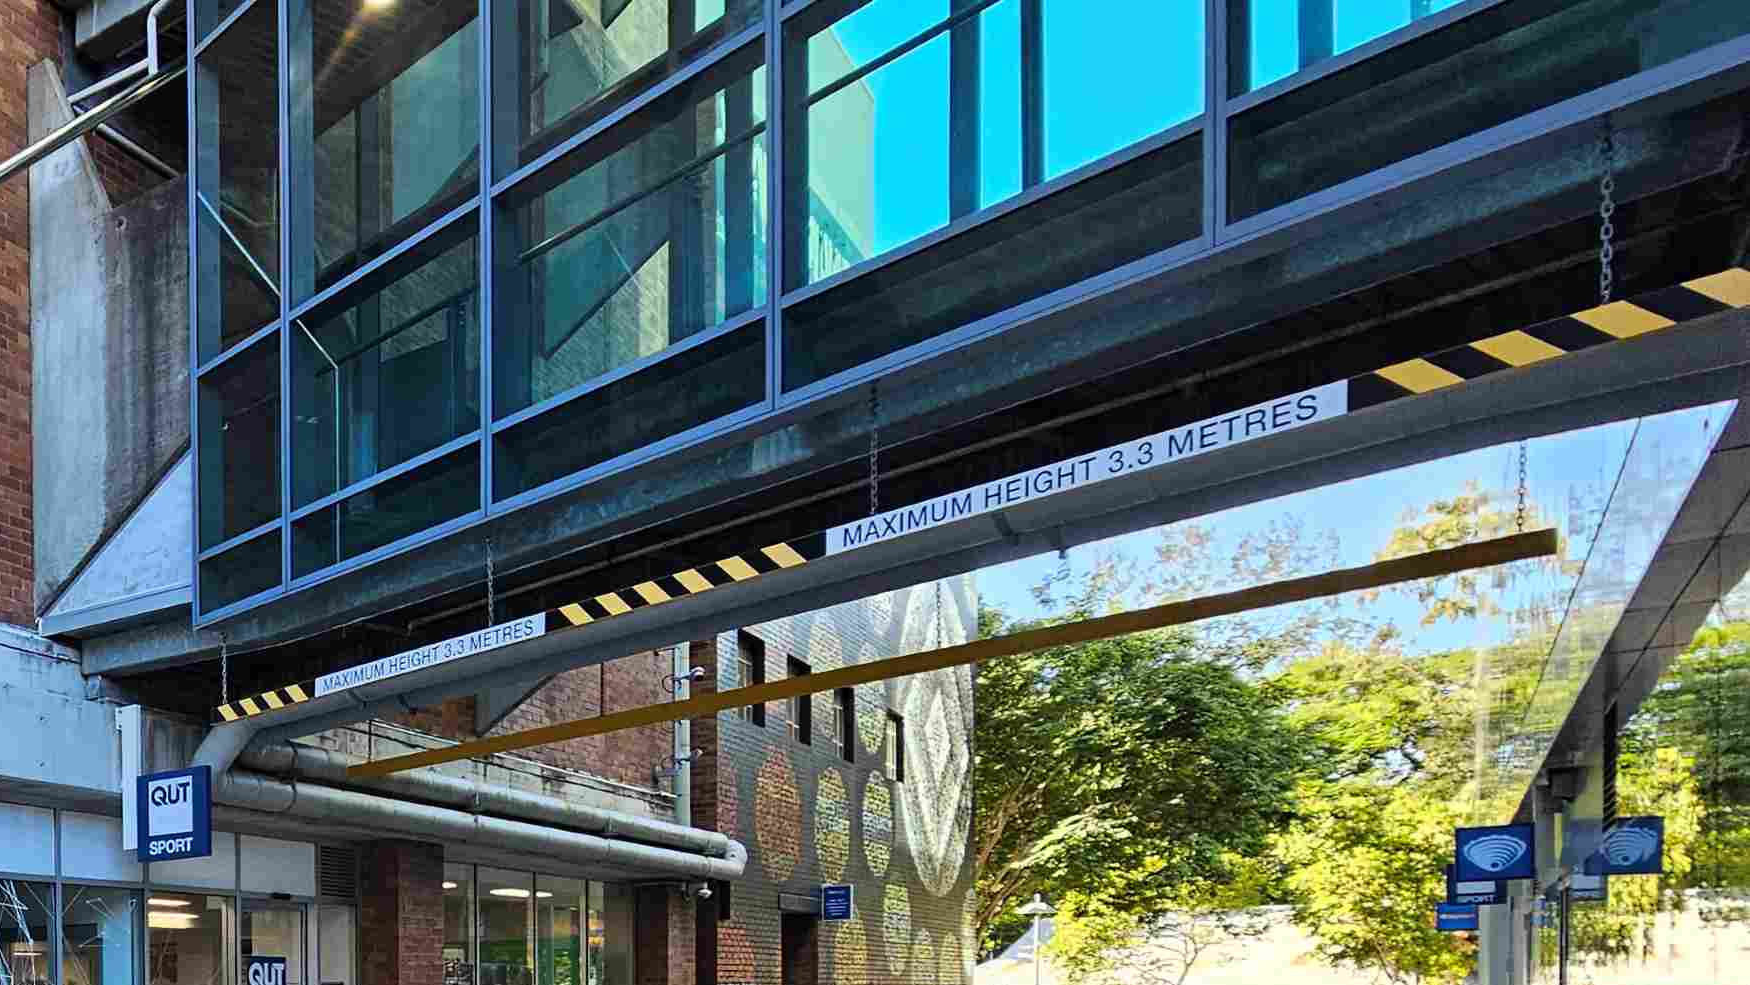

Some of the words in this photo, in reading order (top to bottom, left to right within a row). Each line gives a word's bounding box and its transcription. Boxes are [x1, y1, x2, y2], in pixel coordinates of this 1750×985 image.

[842, 493, 972, 547] MAXIMUM
[985, 456, 1096, 508] HEIGHT
[1108, 442, 1154, 473] 3.3
[1168, 394, 1318, 457] METRES
[322, 664, 385, 692] MAXIMUM
[389, 647, 439, 673] HEIGHT
[444, 639, 465, 659] 3.3
[471, 619, 534, 649] METRES
[151, 782, 190, 807] QUT
[149, 837, 194, 856] SPORT
